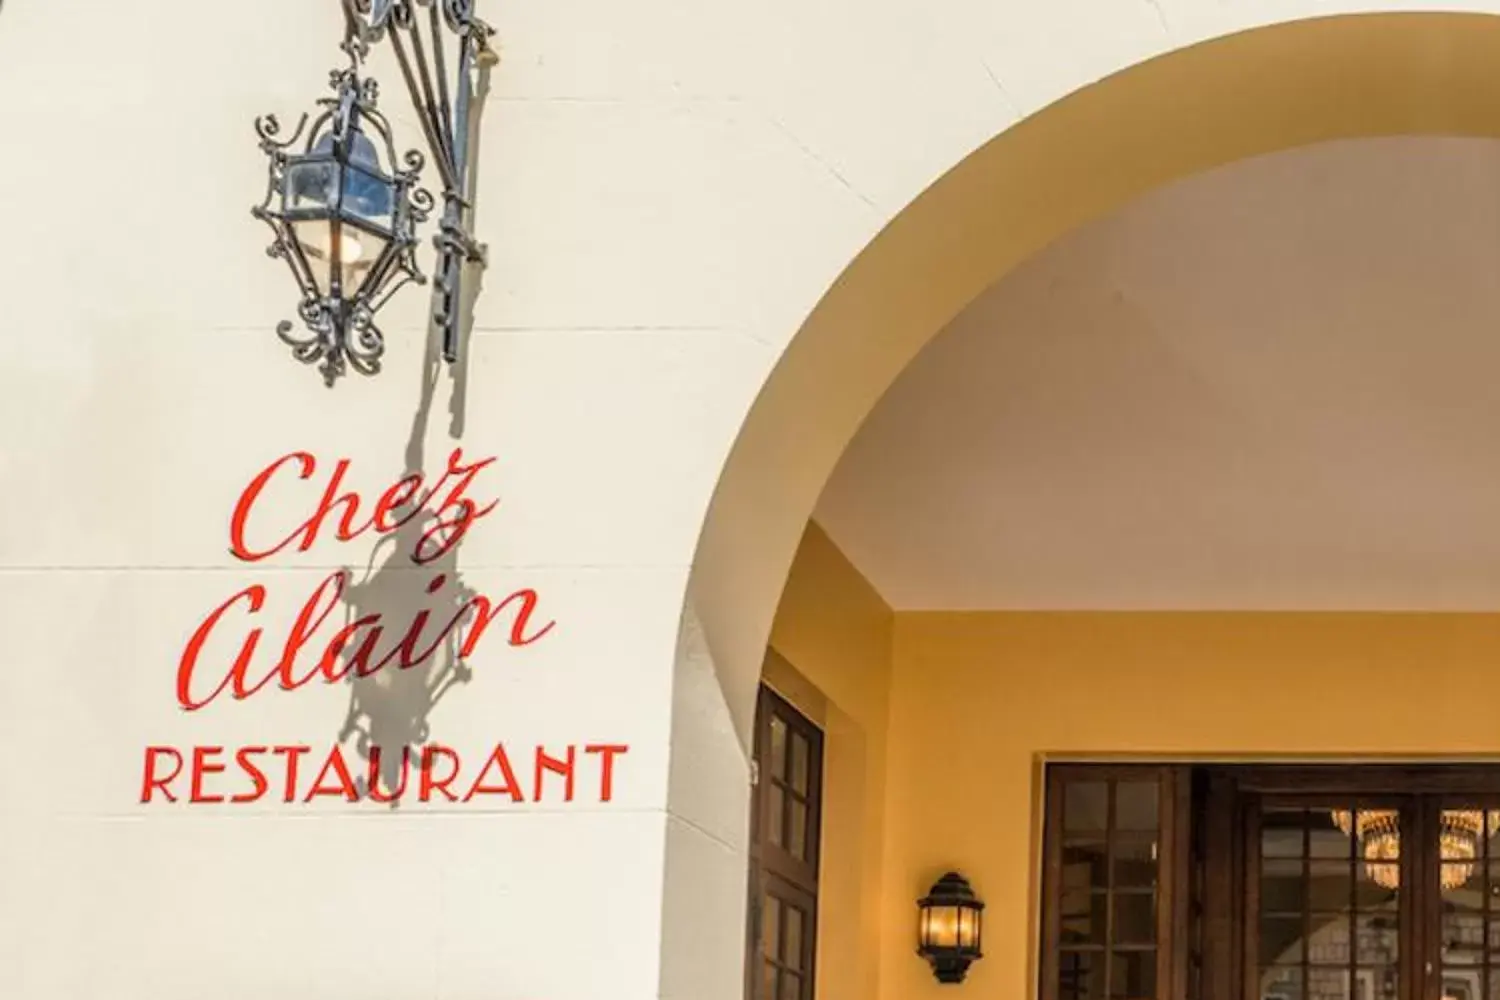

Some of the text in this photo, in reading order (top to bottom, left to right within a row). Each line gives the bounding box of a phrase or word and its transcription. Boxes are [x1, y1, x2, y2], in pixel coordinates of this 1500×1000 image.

[229, 447, 499, 565] Chez
[175, 569, 556, 712] Alain
[139, 742, 631, 804] RESTAURANT
